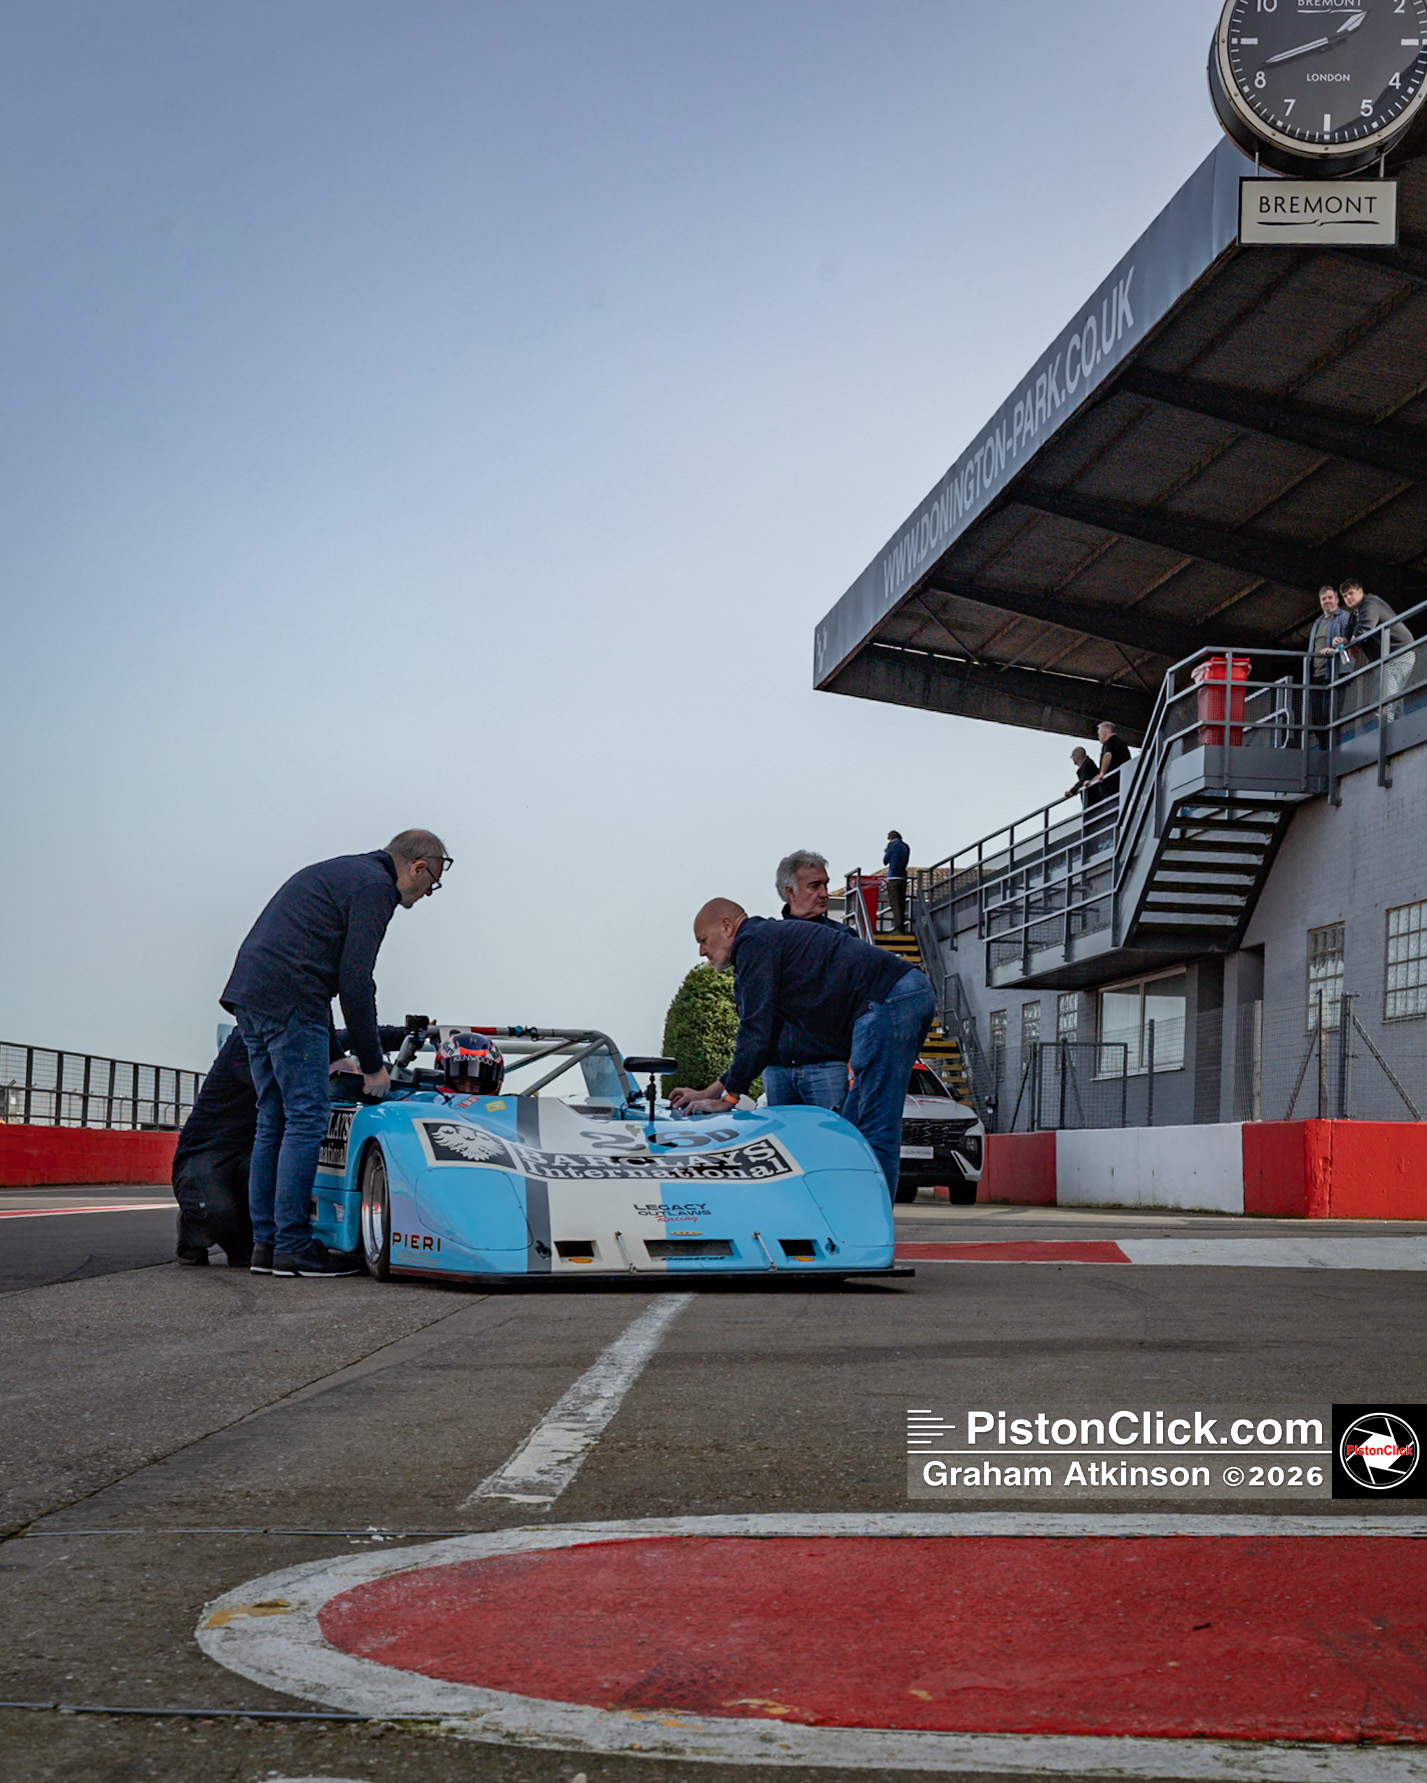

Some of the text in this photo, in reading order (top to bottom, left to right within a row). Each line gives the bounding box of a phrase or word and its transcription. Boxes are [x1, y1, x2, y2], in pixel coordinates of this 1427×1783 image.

[1256, 0, 1277, 13] 10
[1393, 0, 1406, 14] 2
[1254, 70, 1267, 89] 8
[1306, 73, 1351, 83] LONDON
[1388, 72, 1402, 90] 4
[1283, 98, 1297, 117] 7
[1359, 99, 1374, 117] 5
[1258, 195, 1379, 215] BREMONT
[882, 265, 1135, 599] WWW.DONINGTON-PARK.CO.UK
[453, 1053, 494, 1067] KENWOOD
[518, 1142, 776, 1168] BARCLAYS
[523, 1157, 789, 1179] International
[633, 1203, 707, 1211] LEGACY
[655, 1214, 698, 1223] Racing
[392, 1231, 441, 1252] PIERI
